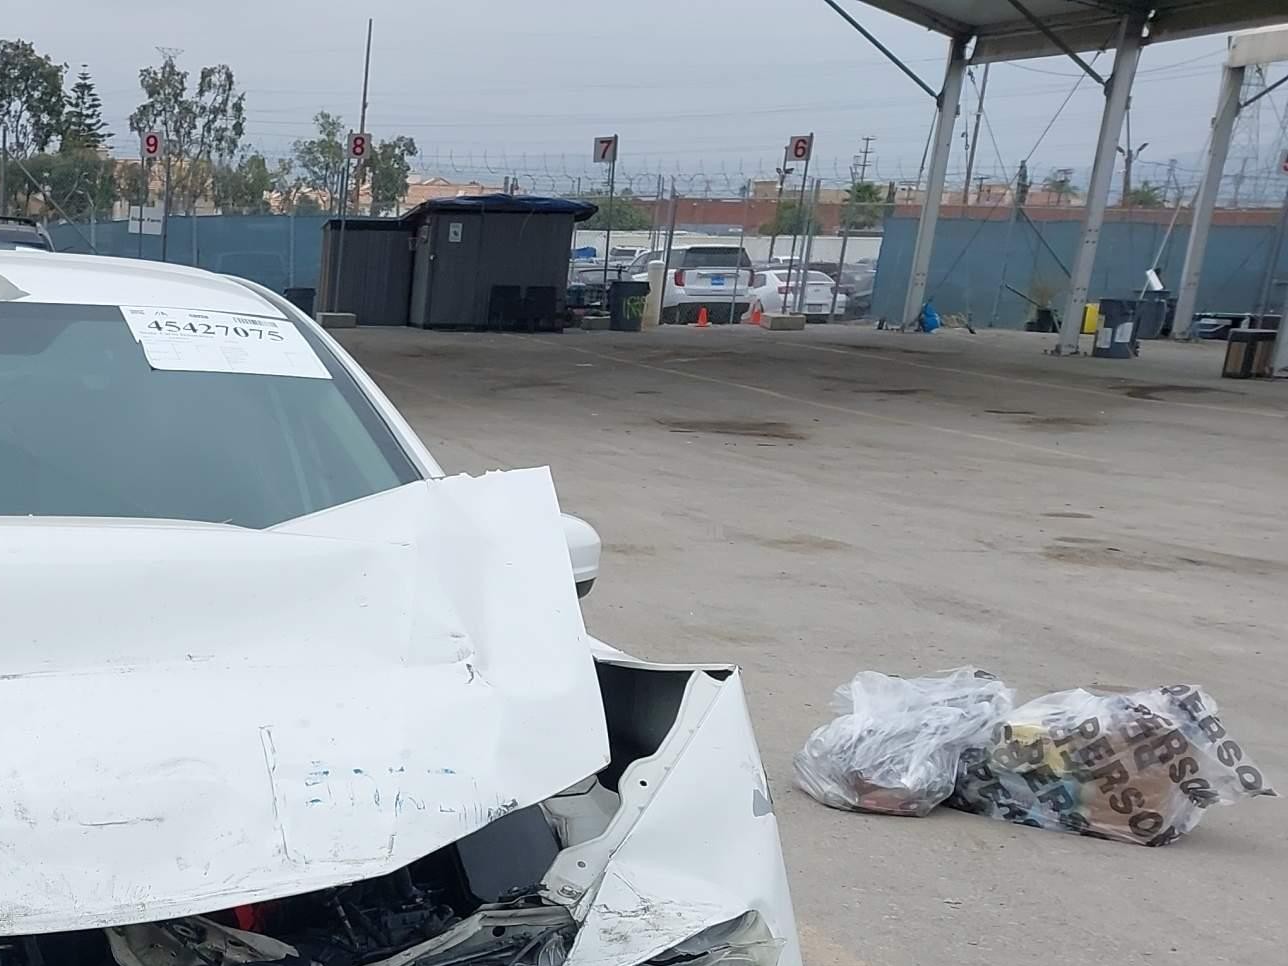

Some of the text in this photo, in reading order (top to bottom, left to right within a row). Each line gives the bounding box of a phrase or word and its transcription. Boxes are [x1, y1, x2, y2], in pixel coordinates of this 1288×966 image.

[145, 135, 159, 154] 9
[351, 136, 365, 156] 8
[600, 139, 613, 159] 7
[793, 138, 808, 158] 6
[148, 319, 285, 343] 45427075
